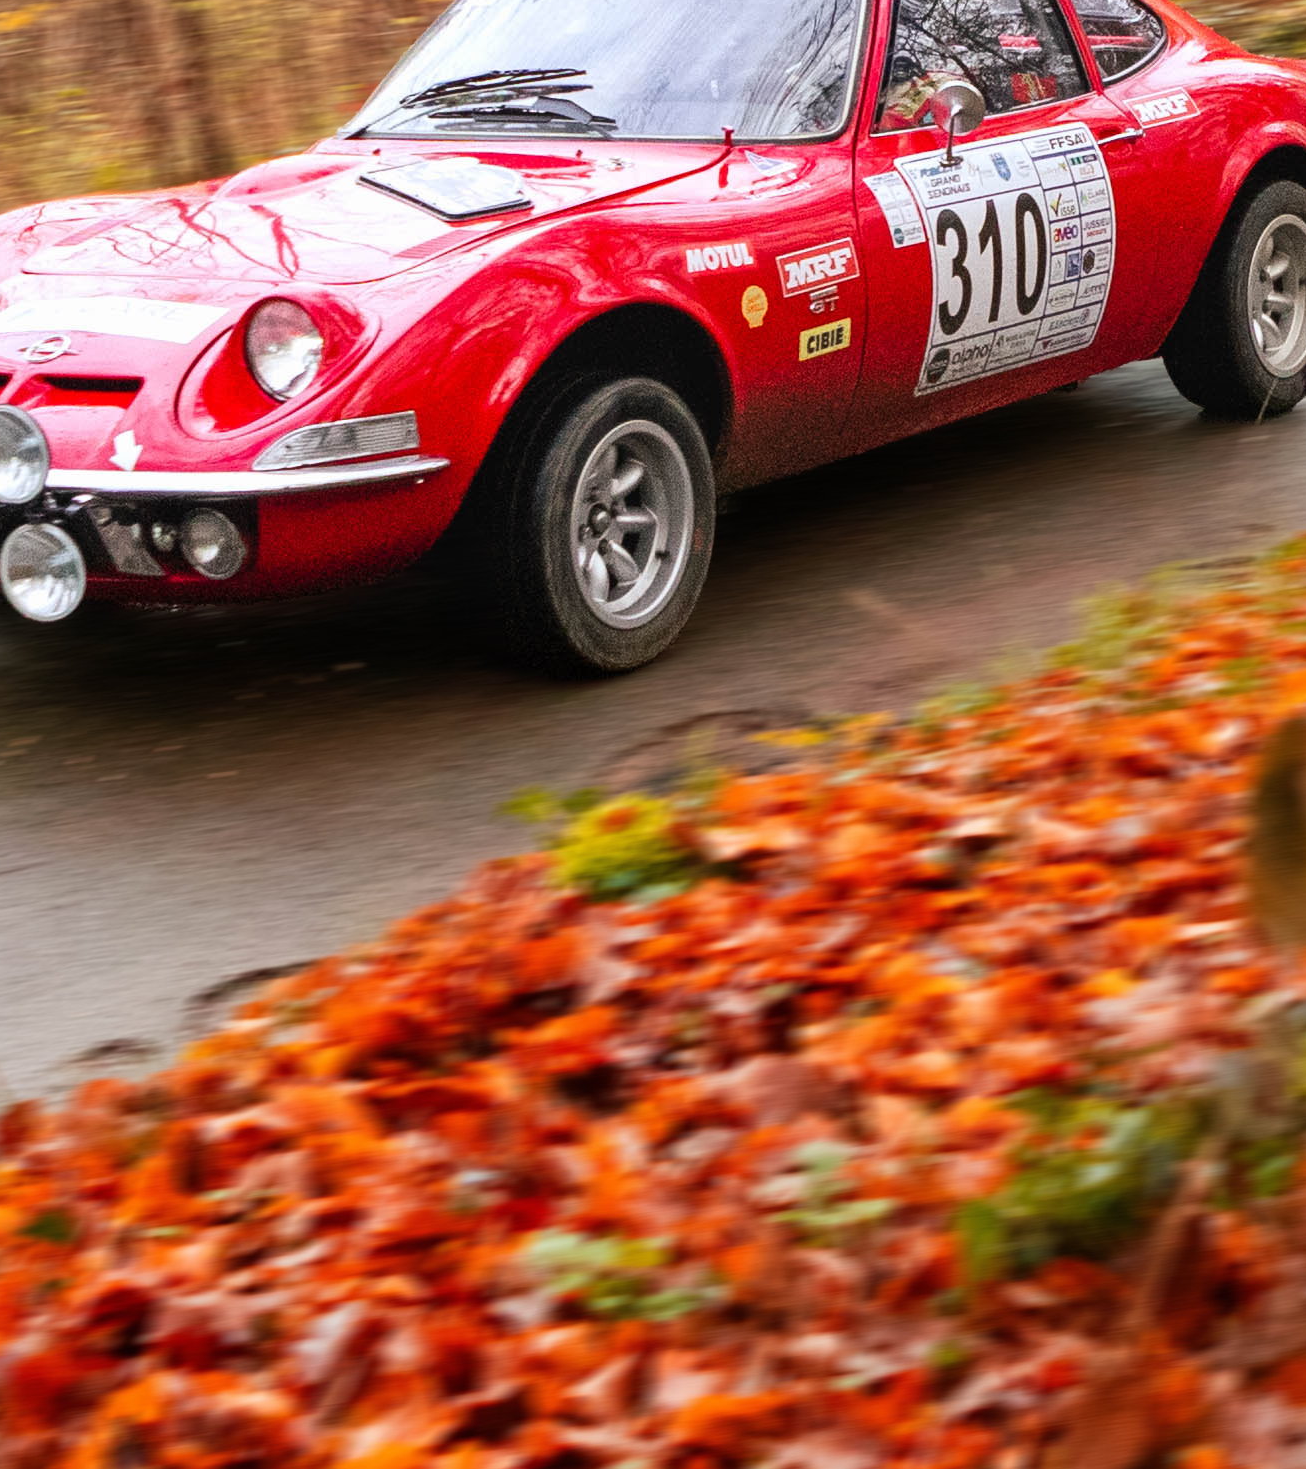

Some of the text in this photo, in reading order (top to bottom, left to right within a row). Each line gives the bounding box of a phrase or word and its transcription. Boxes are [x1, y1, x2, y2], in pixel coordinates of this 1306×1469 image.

[1132, 92, 1189, 123] MRF
[1048, 133, 1084, 150] FFSA
[930, 174, 961, 188] GRAND
[685, 243, 754, 273] MOTUL
[784, 247, 852, 290] MRF
[935, 192, 1046, 336] 310
